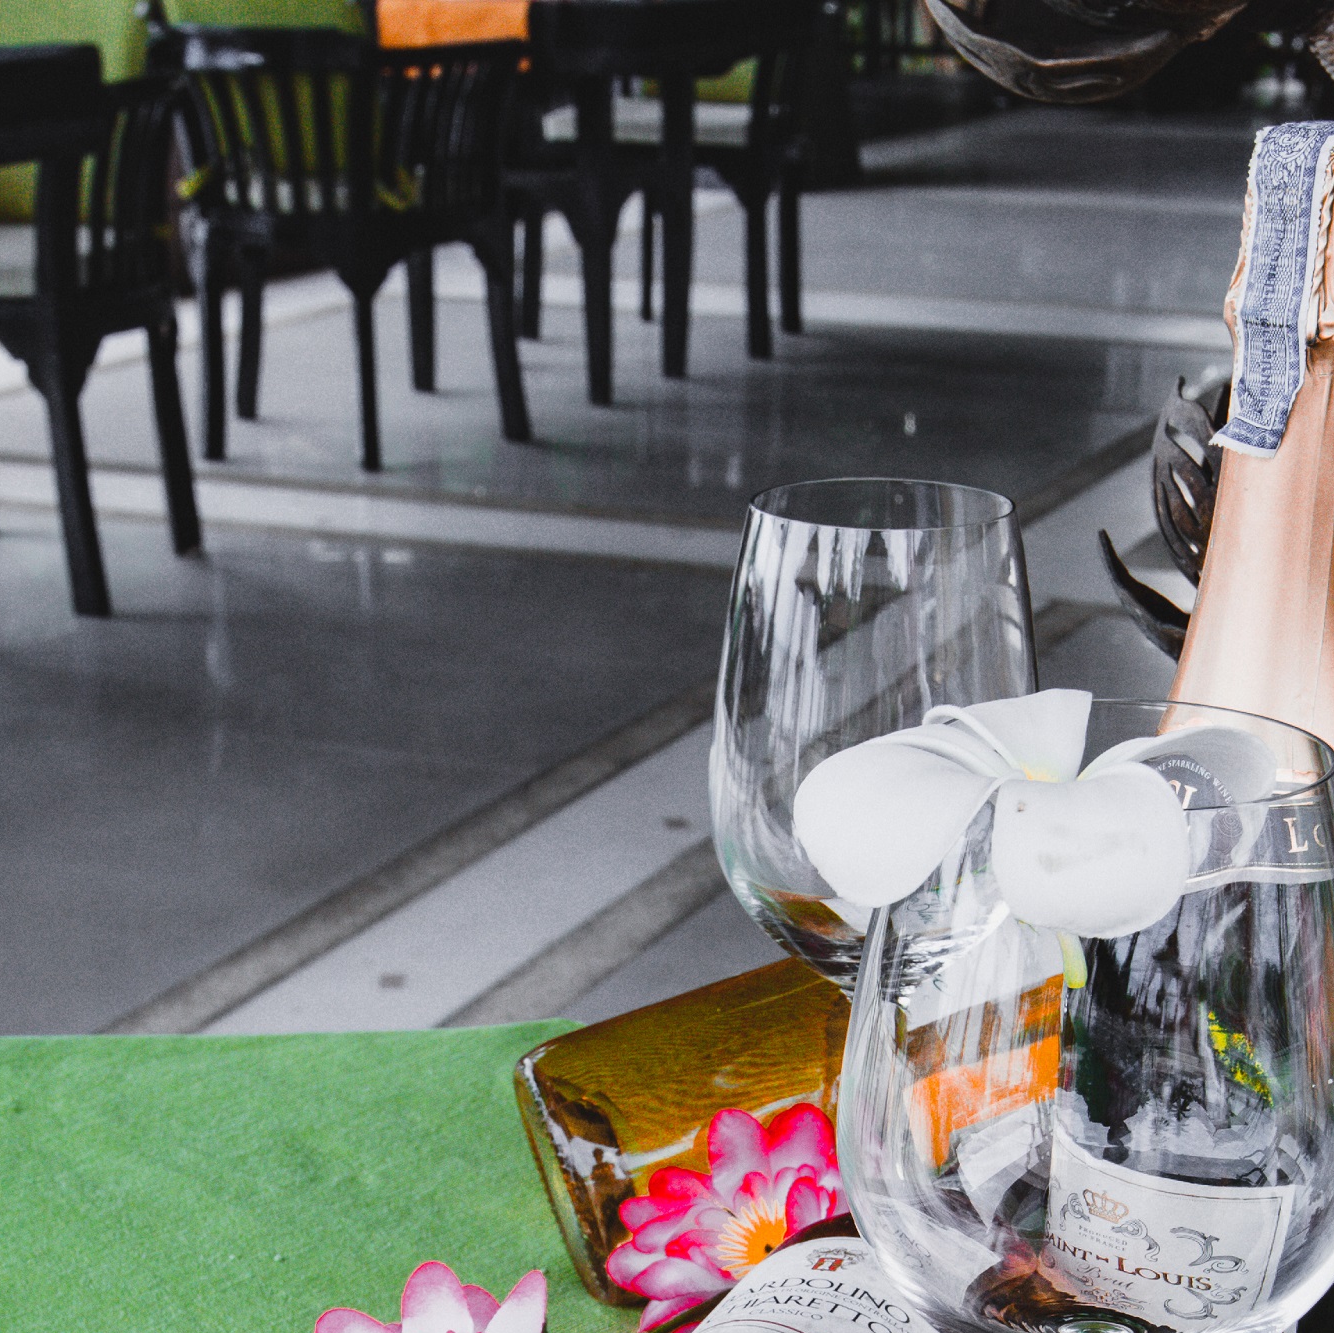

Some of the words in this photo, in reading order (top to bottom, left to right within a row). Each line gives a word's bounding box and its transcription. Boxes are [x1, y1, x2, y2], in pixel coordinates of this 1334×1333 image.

[1167, 759, 1212, 780] SPARKLING
[1212, 777, 1233, 804] WINE
[739, 1277, 910, 1324] ARDOLINO
[749, 1307, 823, 1321] CLASSICO
